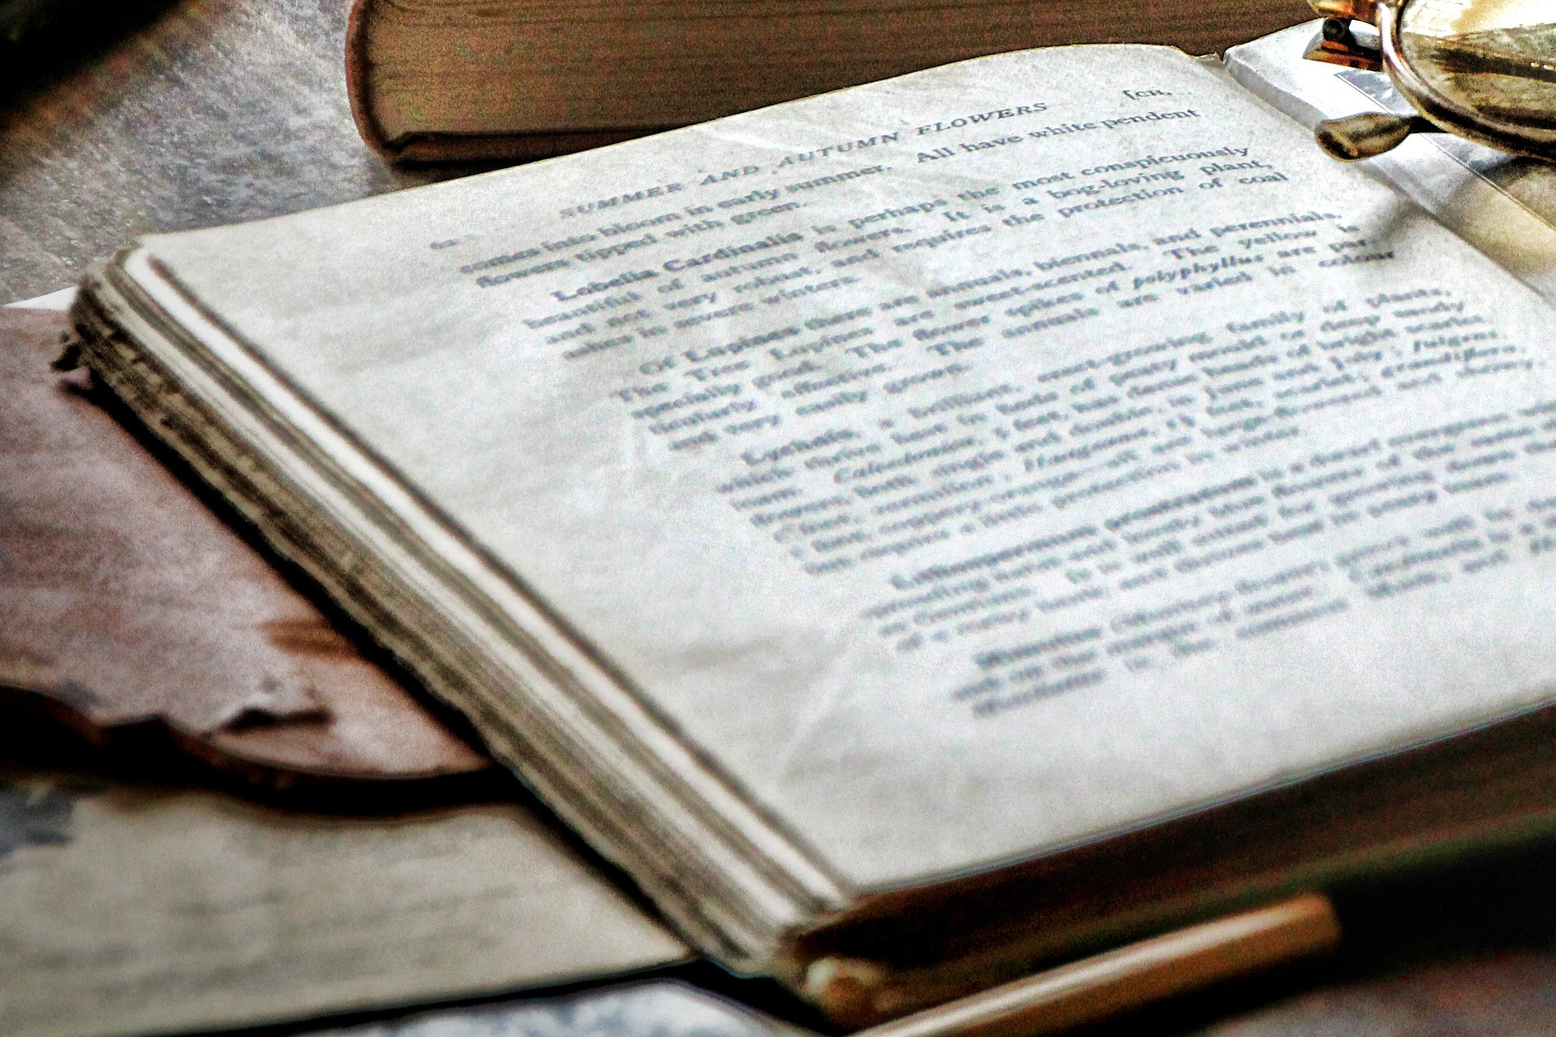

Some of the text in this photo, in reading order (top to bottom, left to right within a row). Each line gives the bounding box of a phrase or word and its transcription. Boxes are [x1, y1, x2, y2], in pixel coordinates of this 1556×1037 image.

[460, 109, 1200, 274] comes into bloom in early summer. All have white pendent
[476, 202, 807, 288] flowers tipped with green.
[523, 160, 1273, 329] beautiful of autumn flowers. It is a bog-loving plant,
[546, 172, 1289, 345] and not very robust, and requires the protection of coal
[552, 147, 1248, 302] Lobelia Cardinalis is perhaps the most conspicuously
